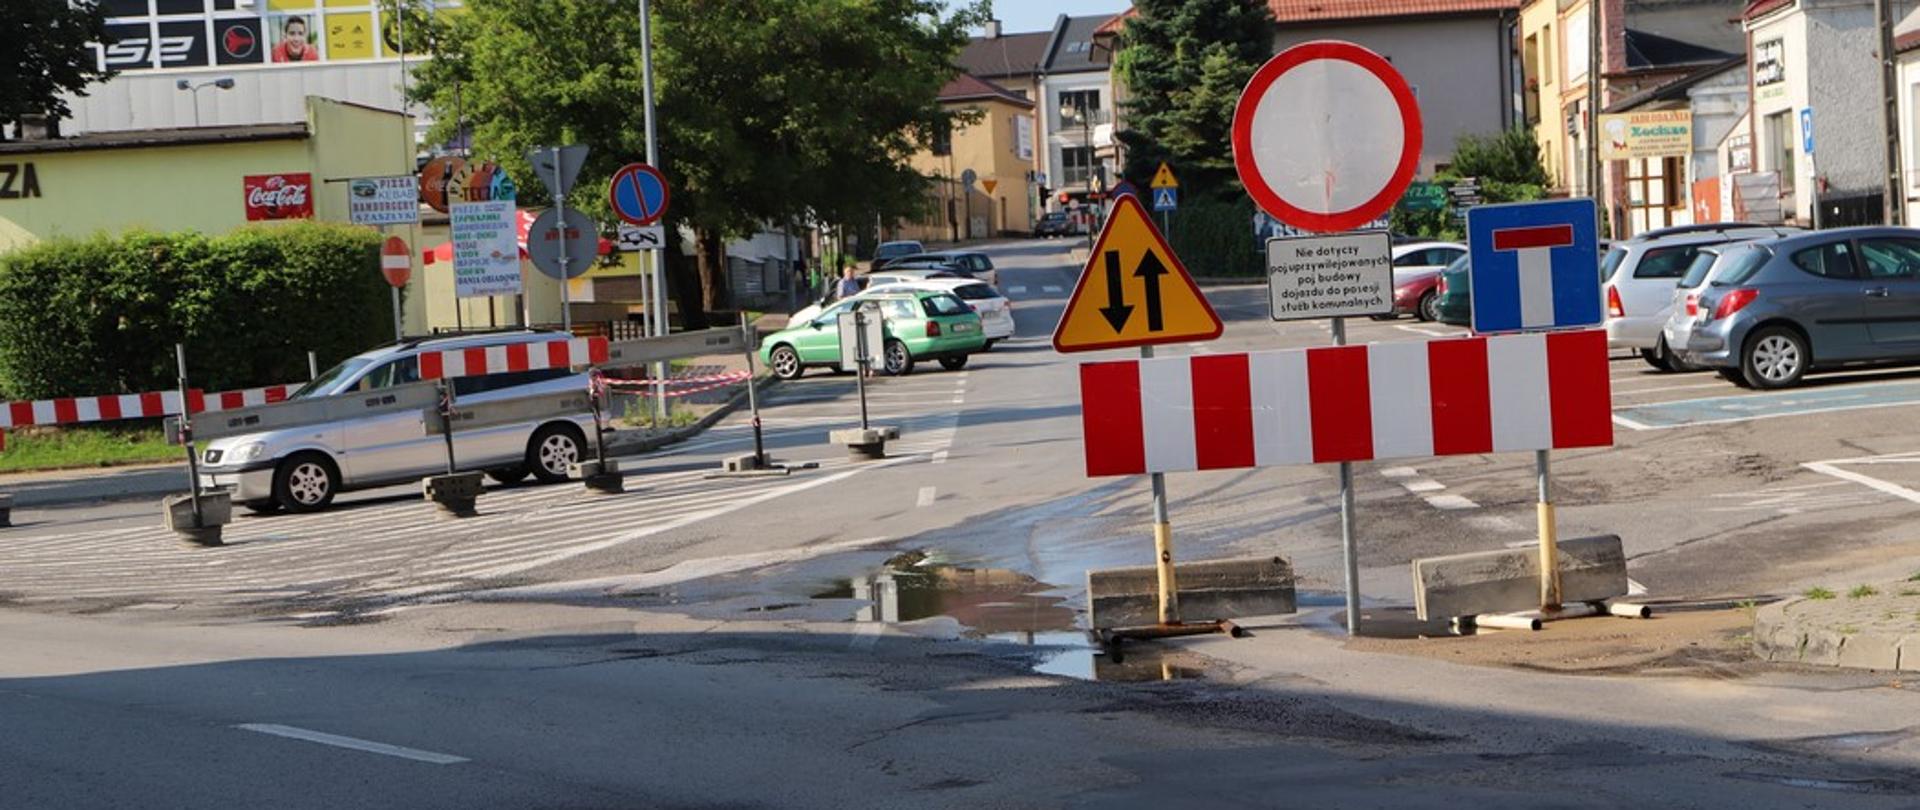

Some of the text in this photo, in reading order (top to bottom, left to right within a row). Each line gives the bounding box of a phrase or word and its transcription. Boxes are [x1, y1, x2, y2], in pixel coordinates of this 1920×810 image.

[380, 177, 412, 189] PIZZA
[379, 189, 415, 199] KEBAB
[353, 201, 415, 212] HAMBURGERY
[1295, 246, 1360, 257] Nie dotyczy
[1297, 272, 1361, 286] poj budowy
[1281, 282, 1379, 300] dojazdu do posesji
[1312, 295, 1383, 310] komunalnych
